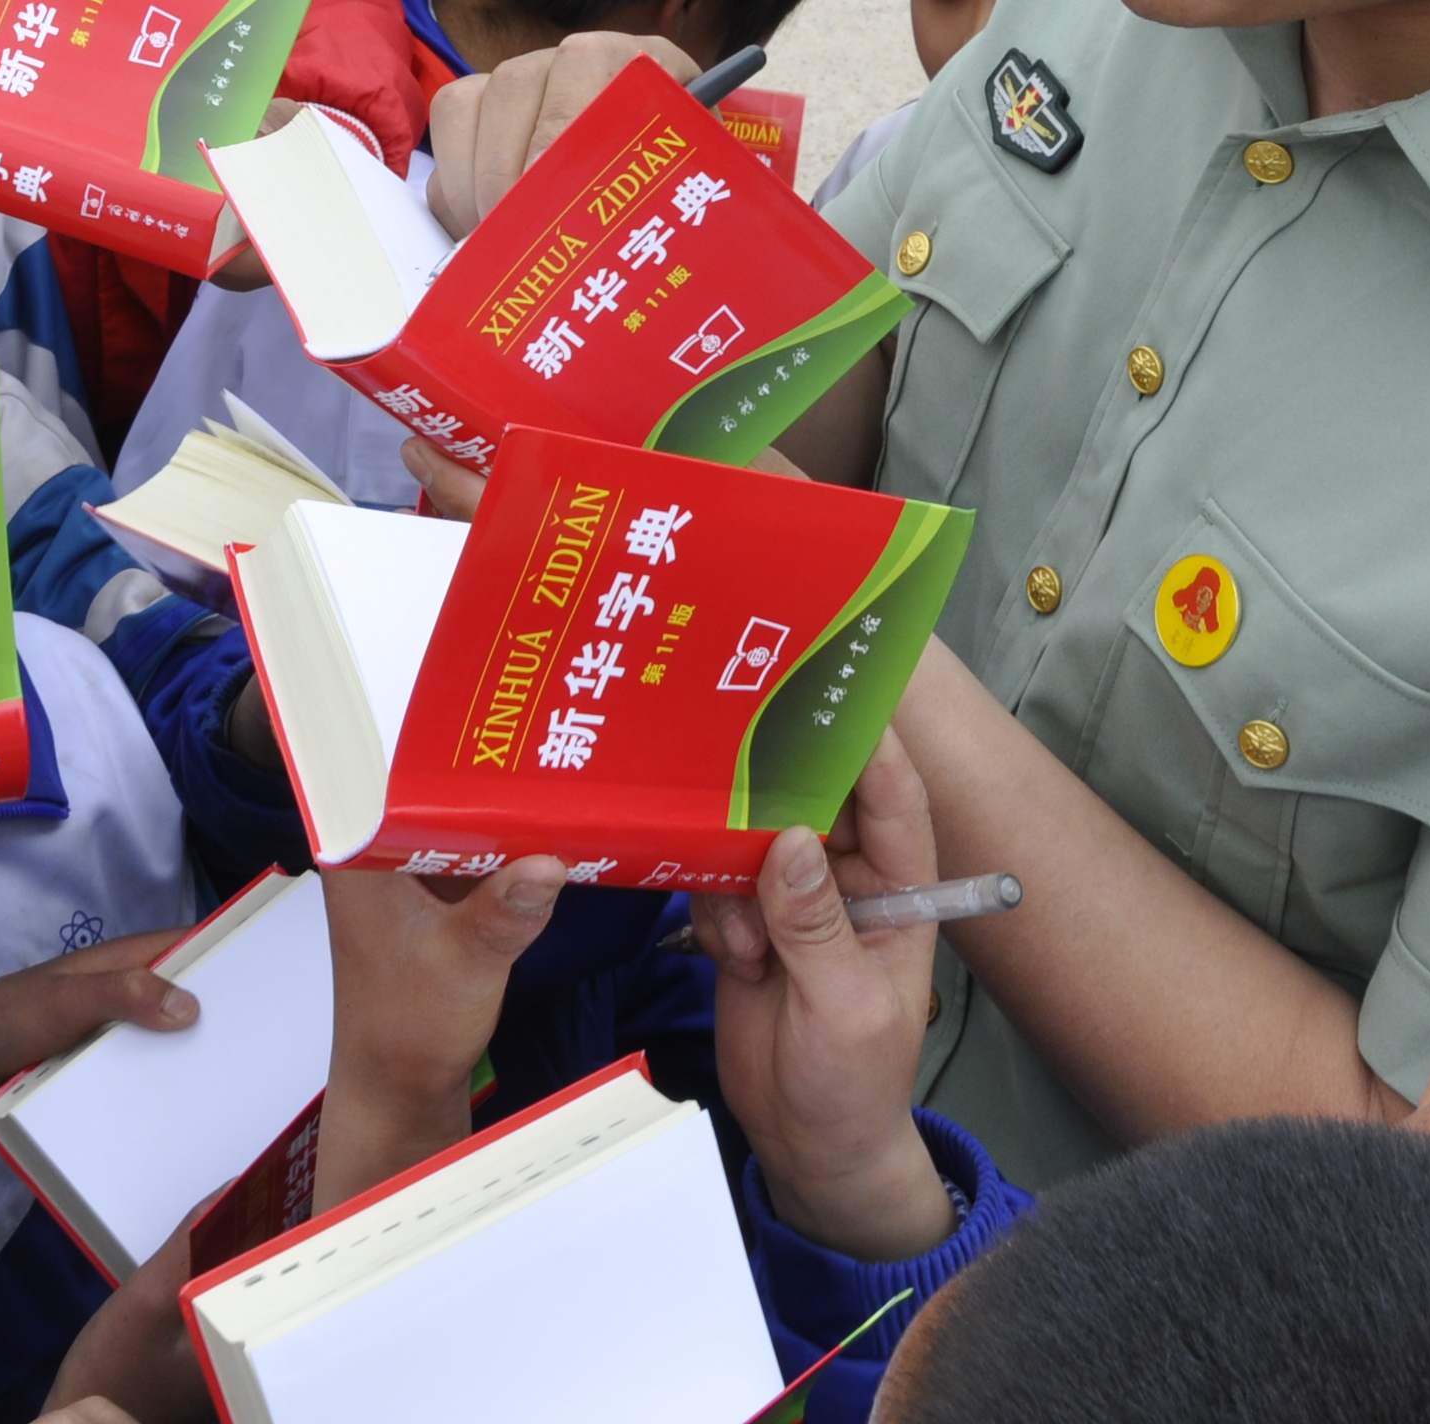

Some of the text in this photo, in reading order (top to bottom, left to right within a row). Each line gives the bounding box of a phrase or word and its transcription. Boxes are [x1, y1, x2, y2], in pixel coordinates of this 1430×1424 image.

[522, 171, 732, 380] 新华字典
[622, 264, 692, 334] 第11版
[373, 383, 496, 477] 新华字
[537, 503, 694, 771] 新华字典
[640, 603, 696, 686] 第11版
[395, 849, 618, 883] 新华典
